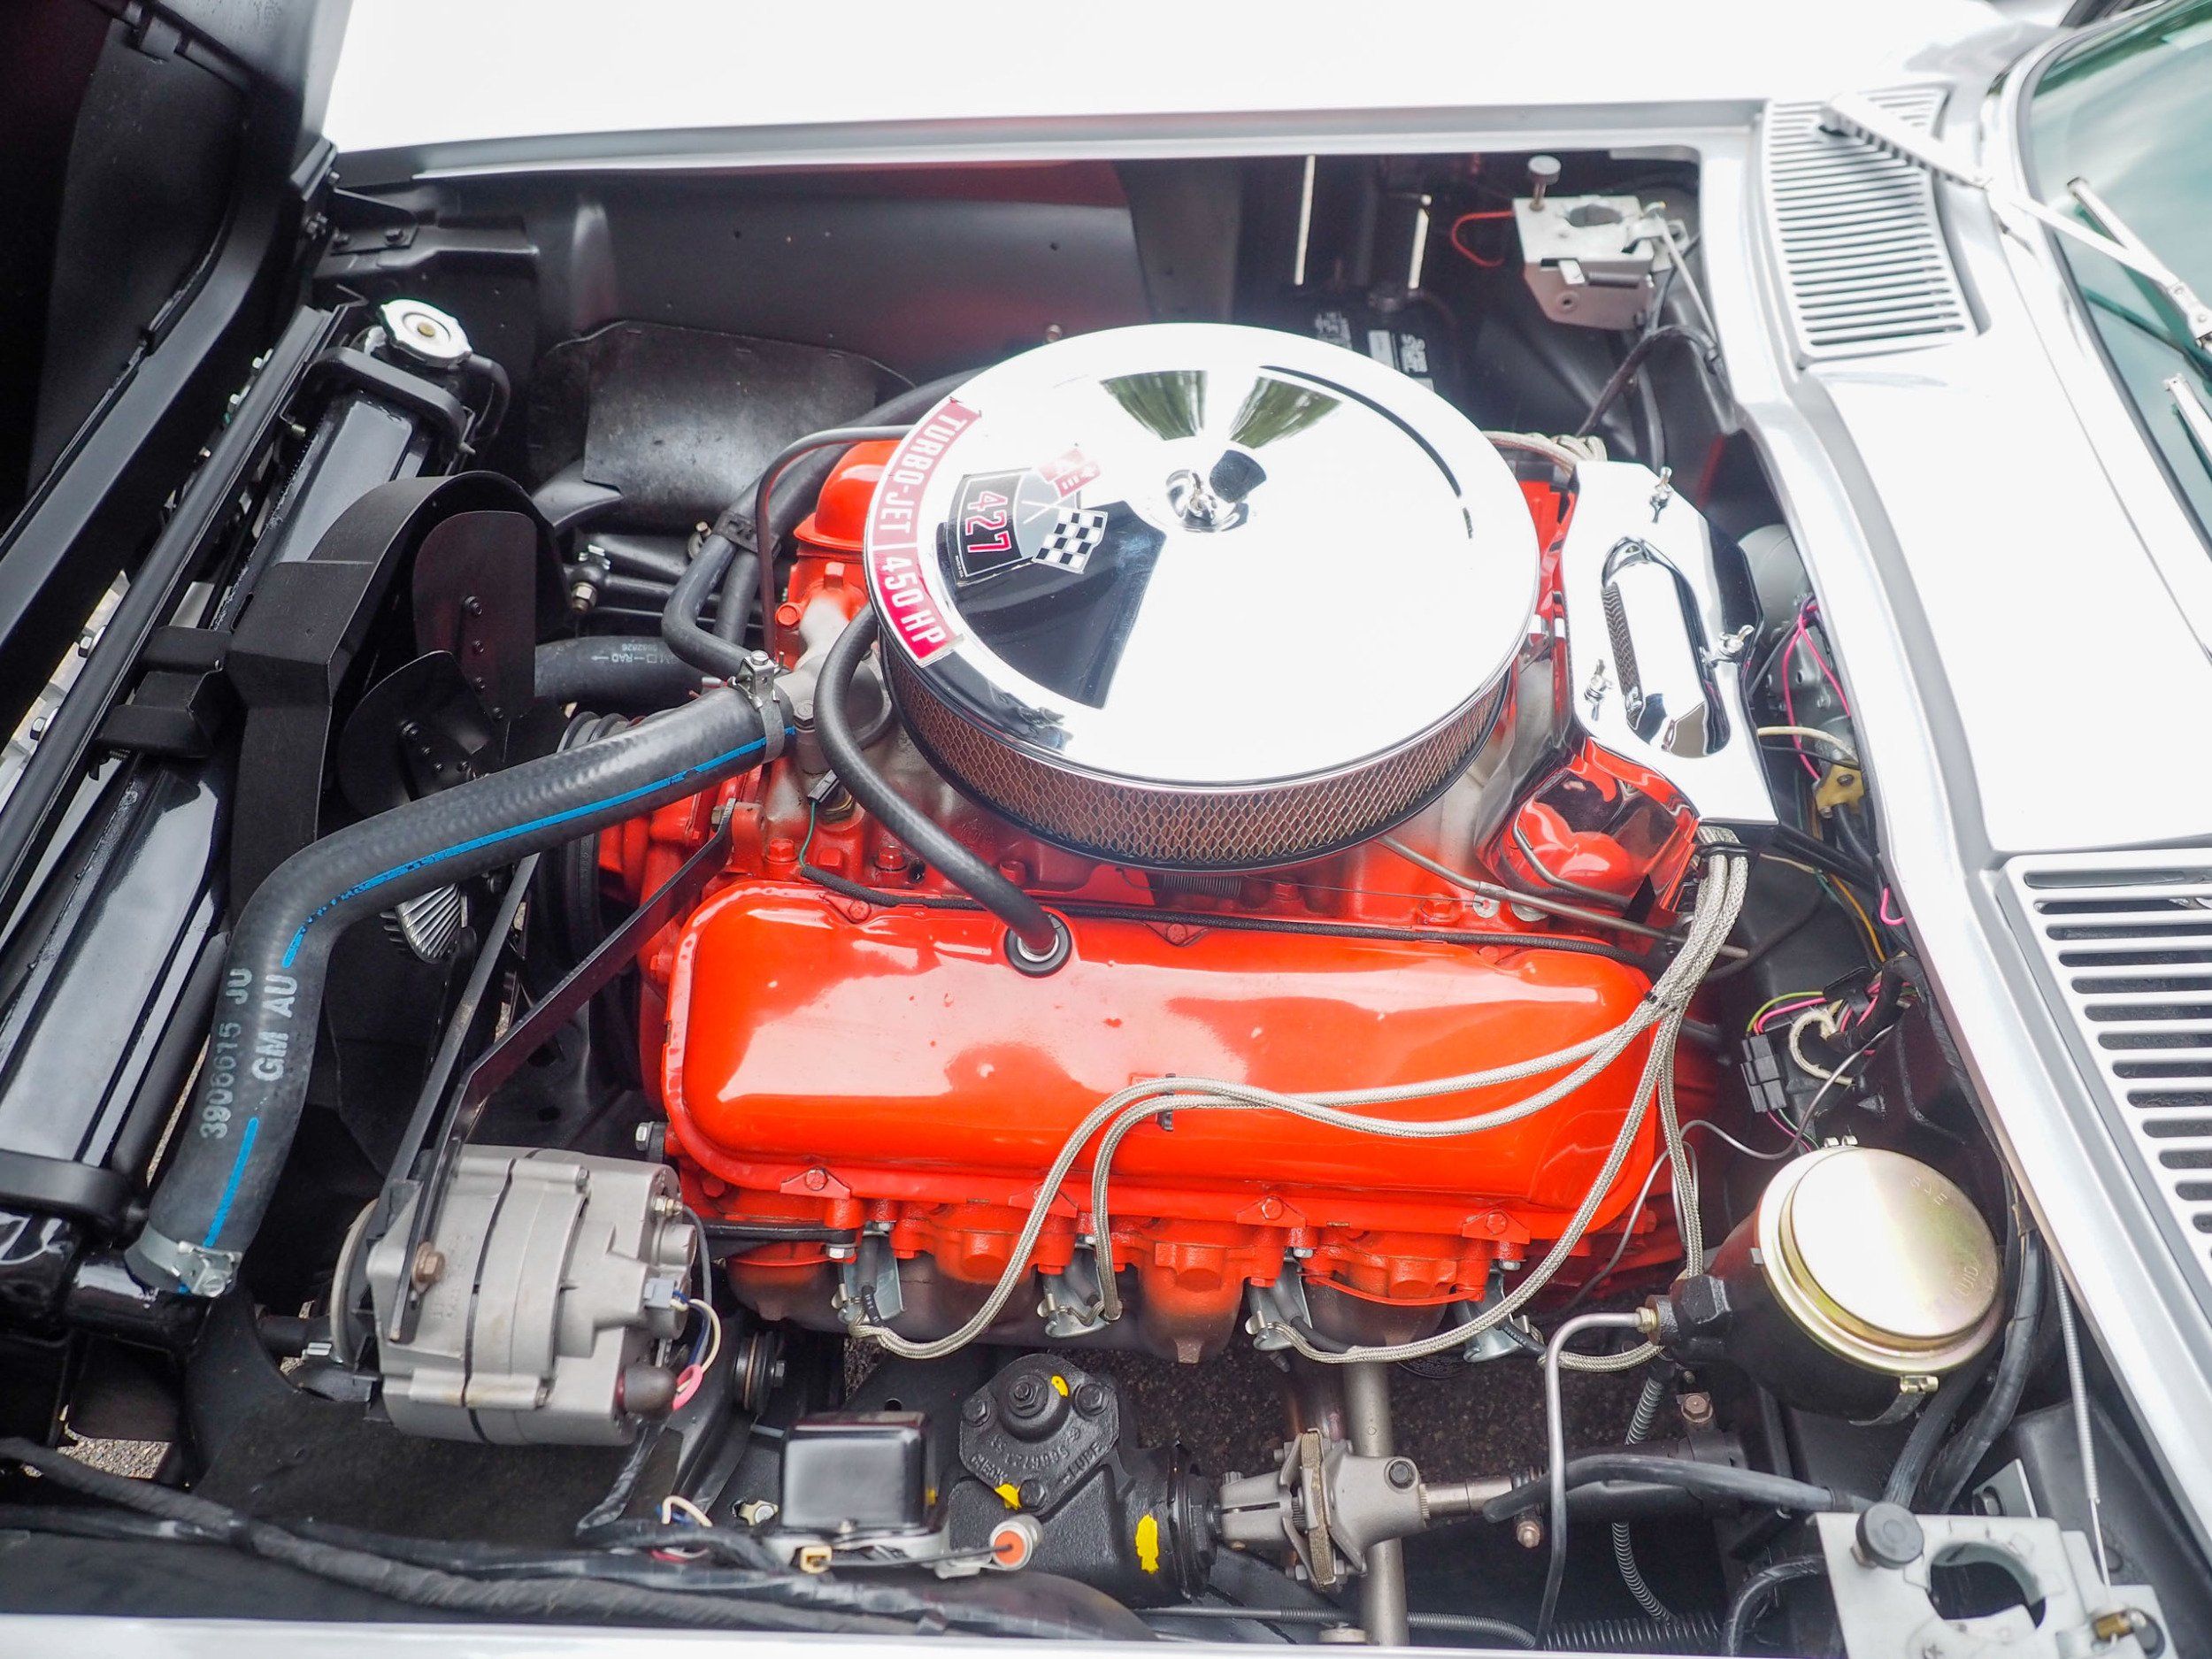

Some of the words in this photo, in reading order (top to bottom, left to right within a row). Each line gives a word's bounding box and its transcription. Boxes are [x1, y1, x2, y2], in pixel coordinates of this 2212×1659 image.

[879, 413, 967, 534] TURBO-JET
[964, 491, 1011, 553] 427
[883, 556, 921, 608] 450
[901, 607, 946, 644] HP
[612, 653, 633, 662] RAD
[226, 968, 252, 1005] JU
[262, 974, 297, 1018] AU
[251, 1031, 288, 1081] GM
